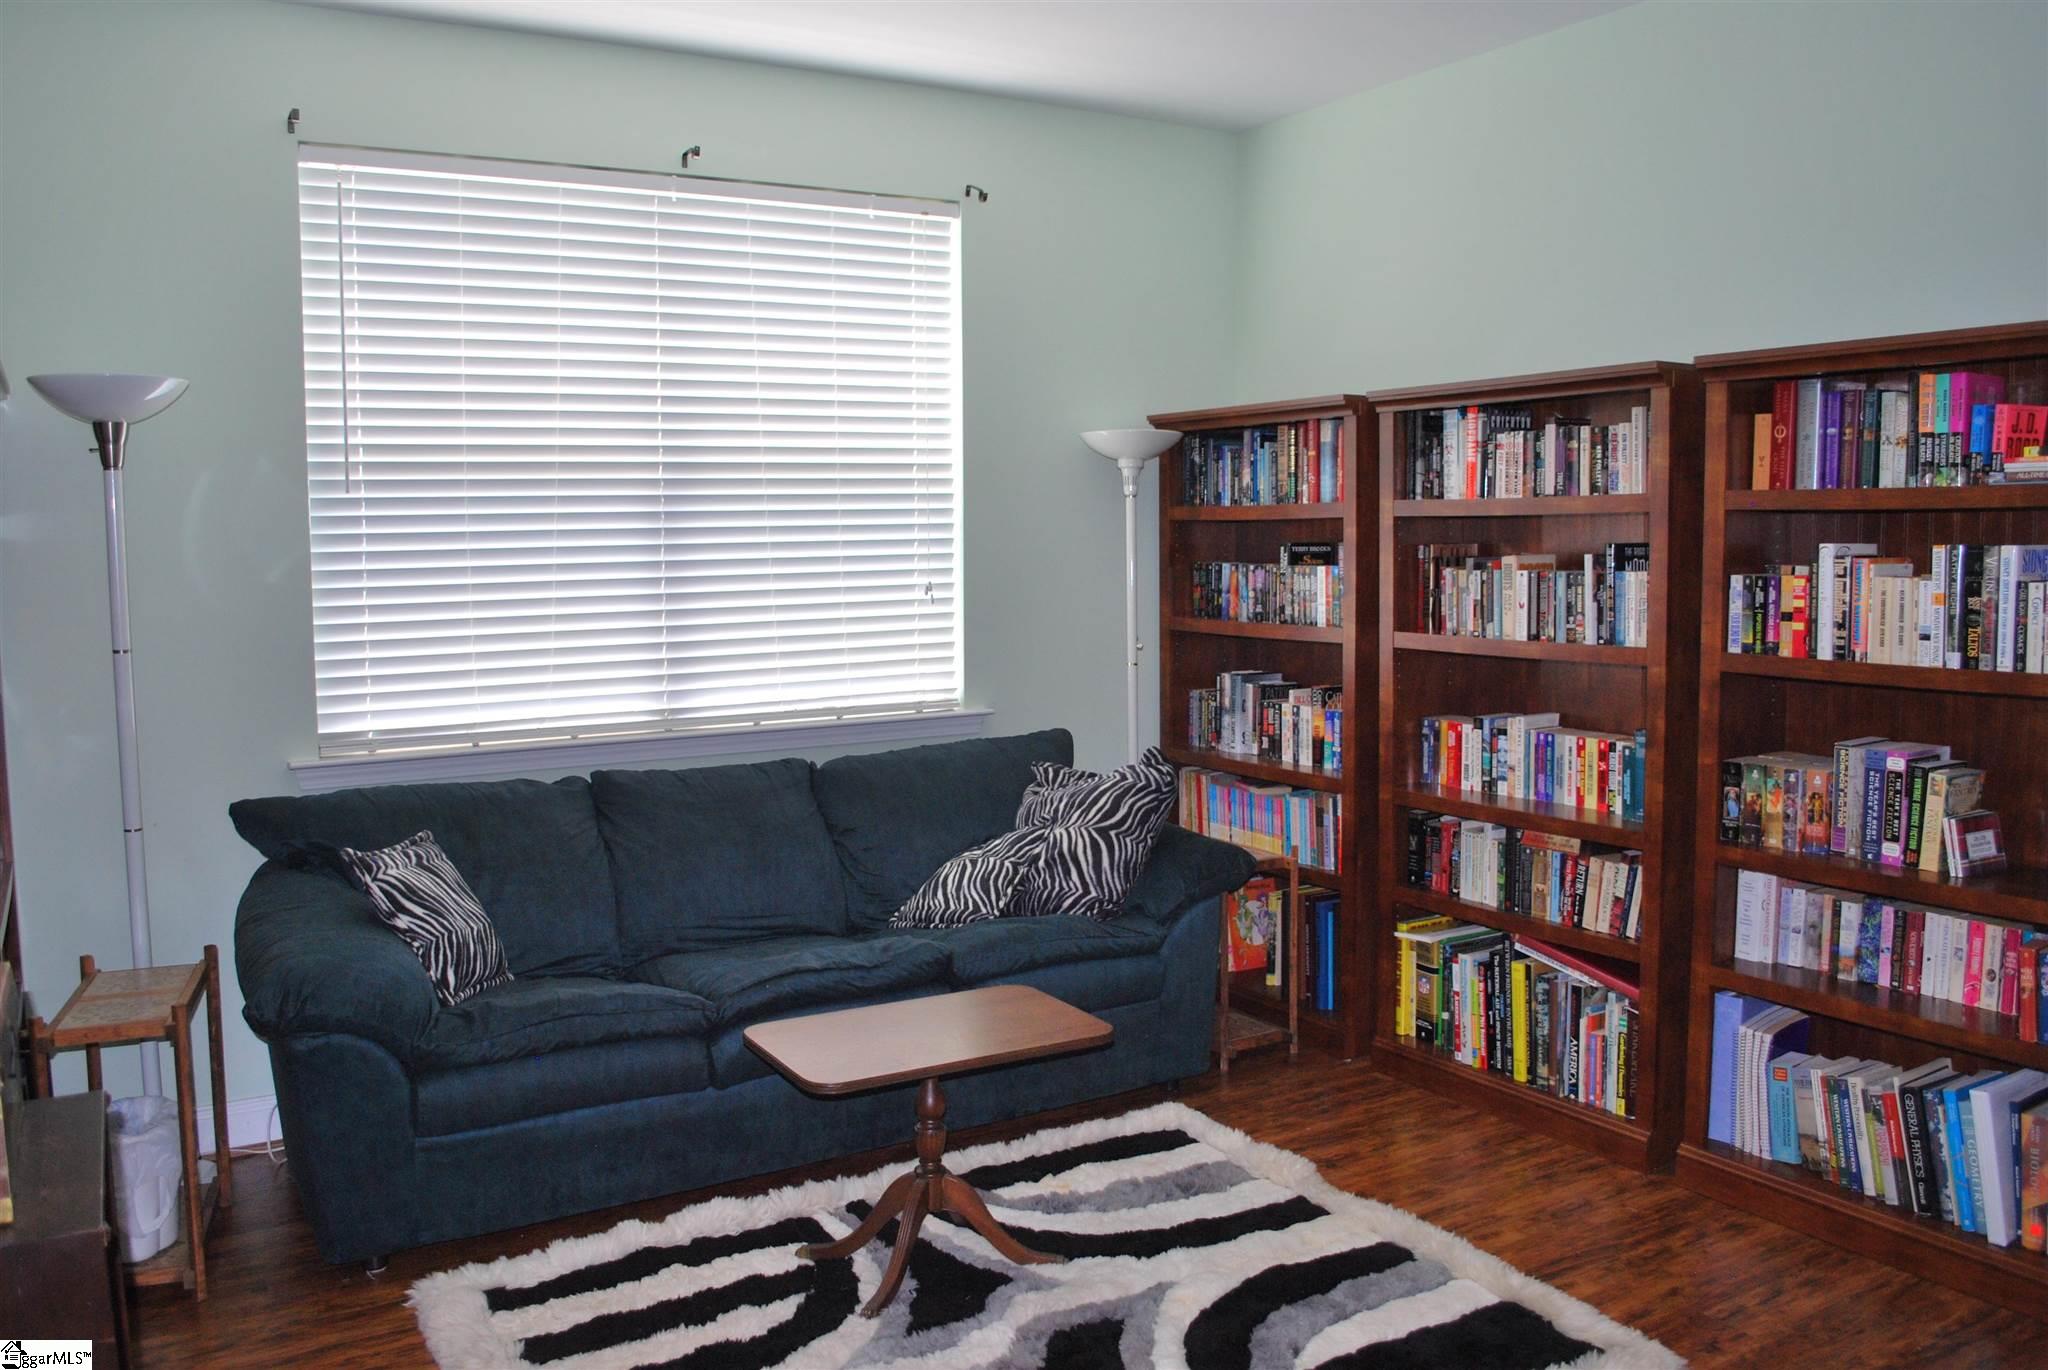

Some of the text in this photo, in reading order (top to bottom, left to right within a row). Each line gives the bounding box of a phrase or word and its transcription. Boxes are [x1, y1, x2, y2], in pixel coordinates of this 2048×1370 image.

[2012, 412, 2039, 435] J. D.
[1503, 563, 1513, 591] ROOTS
[1951, 549, 1959, 580] KATHY
[1985, 556, 1998, 593] VIOLIN
[1967, 626, 1980, 658] TALTOS
[2016, 624, 2025, 655] COSMOS
[1838, 749, 1846, 787] SCIENCE
[1887, 773, 1896, 807] SCIENCE
[1909, 778, 1922, 850] VINTAGE SCIENCE FICTION
[1575, 864, 1585, 896] RETURN
[1495, 1041, 1503, 1069] MUSEUM
[1569, 1036, 1579, 1084] AMERICA
[1619, 1033, 1627, 1065] Gardening
[1833, 1093, 1841, 1123] WESTERN
[1843, 1098, 1852, 1128] WESTERN
[1904, 1093, 1920, 1139] GENERAL
[1910, 1139, 1925, 1179] PHYSICS
[1966, 1138, 1984, 1208] GEOMETRY
[2029, 1147, 2042, 1202] BIOLOGY
